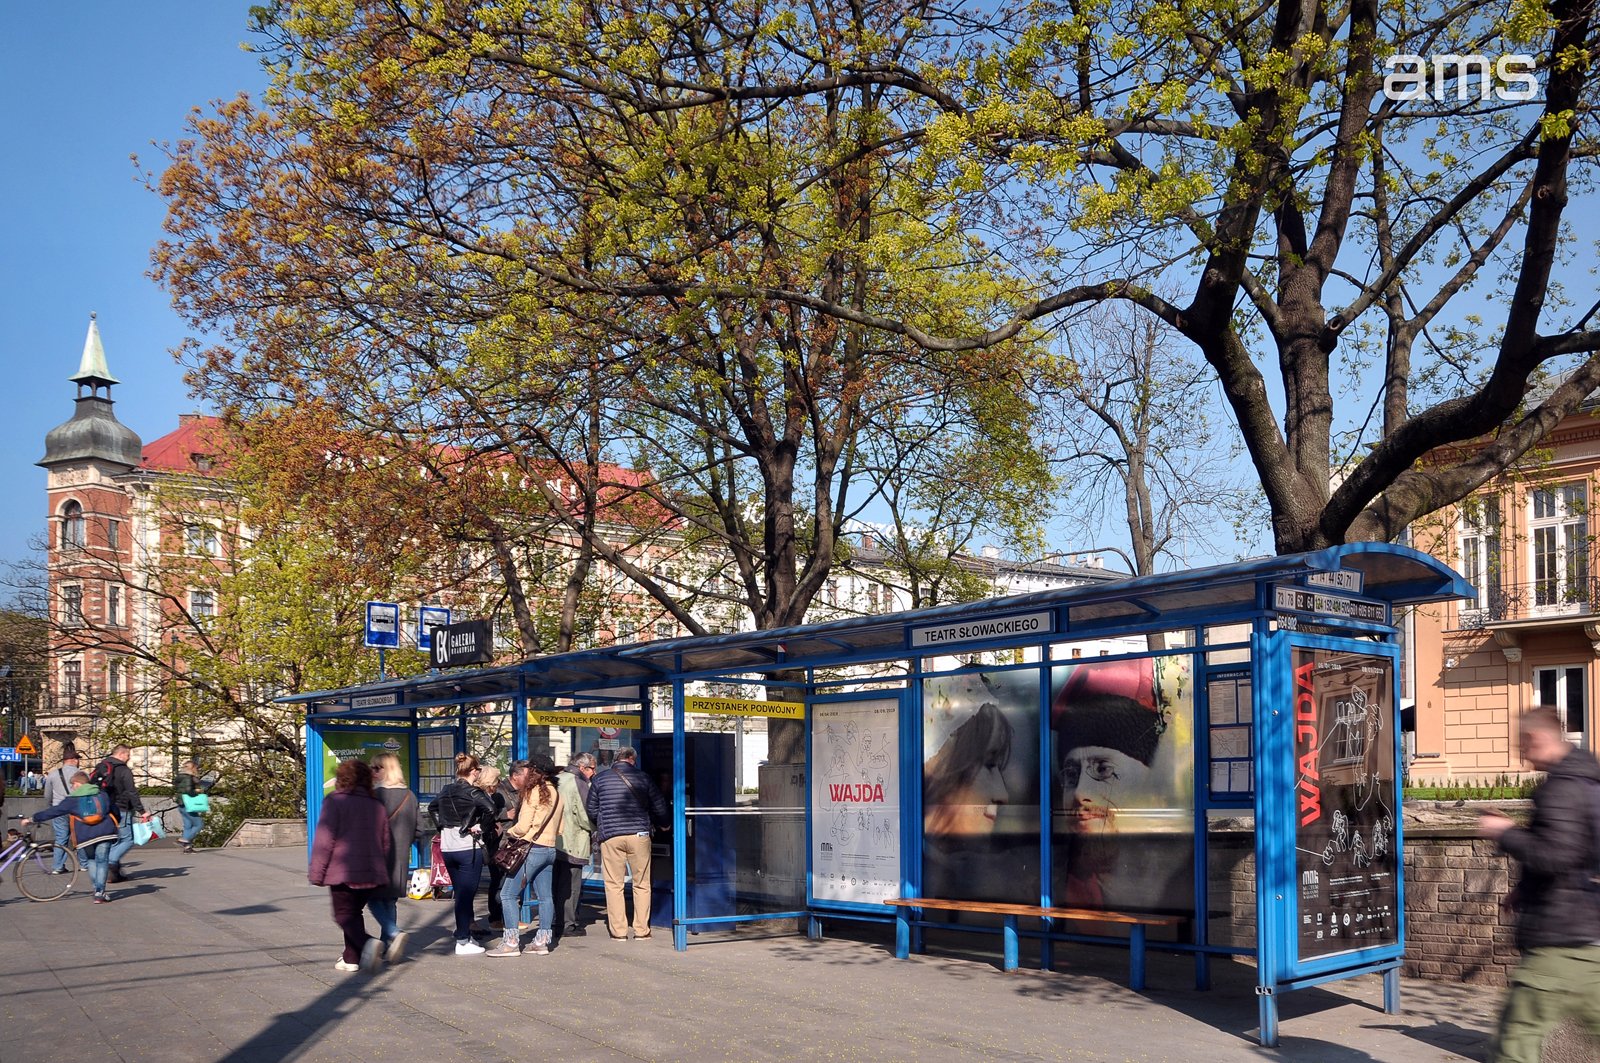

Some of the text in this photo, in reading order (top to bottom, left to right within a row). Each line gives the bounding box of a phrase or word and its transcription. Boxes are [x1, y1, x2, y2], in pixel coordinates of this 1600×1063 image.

[1336, 573, 1343, 586] 52
[1345, 574, 1352, 587] 71
[1296, 594, 1304, 608] 62
[1306, 596, 1314, 609] 64
[1324, 599, 1332, 612] 152
[925, 618, 1039, 642] TEATR SŁOWACKIEGO
[450, 631, 476, 648] GALERIA
[692, 700, 797, 714] PRZYSTANEK PODWÓJNY
[539, 715, 629, 726] PRZYSTANEK PODWÓJNY
[1295, 662, 1321, 828] WAJDA
[828, 783, 885, 803] WAJDA
